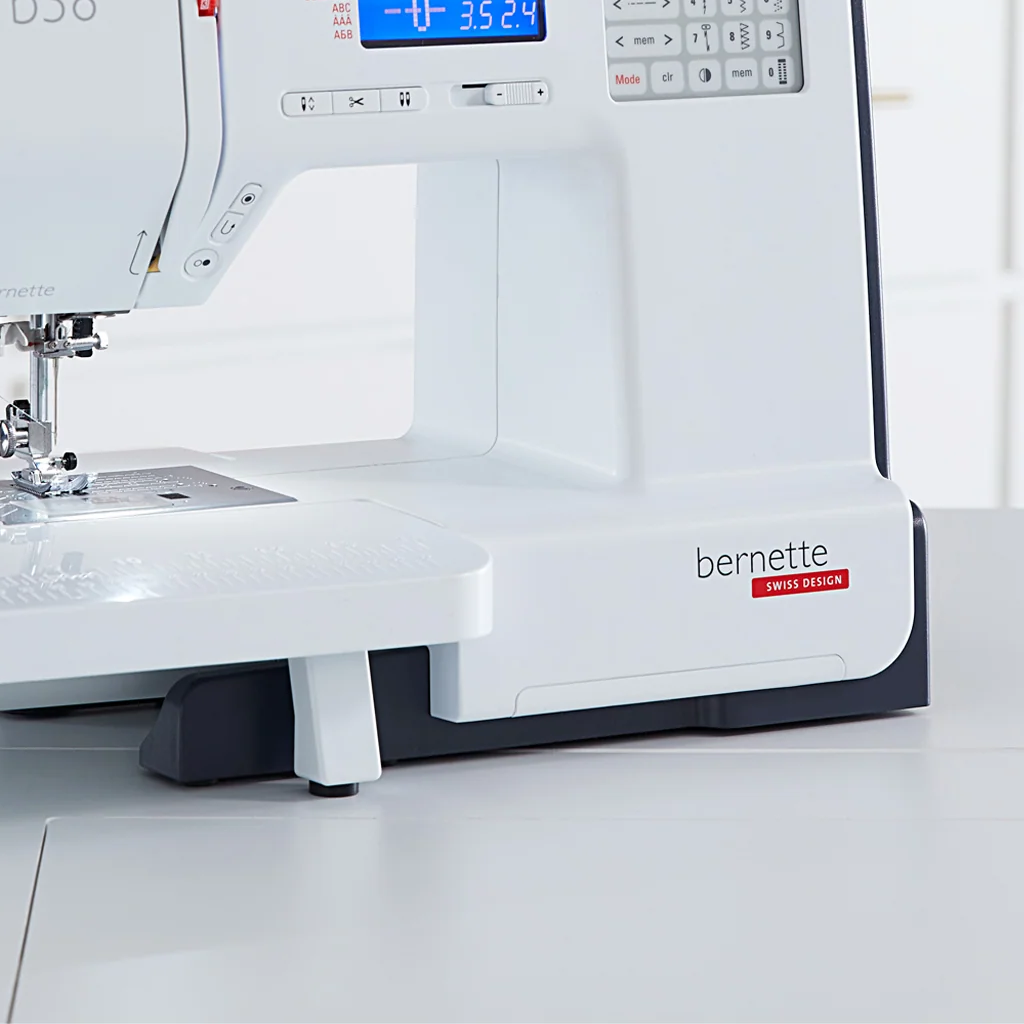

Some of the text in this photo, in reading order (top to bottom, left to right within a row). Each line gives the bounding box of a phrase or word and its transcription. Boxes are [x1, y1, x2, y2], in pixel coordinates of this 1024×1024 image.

[332, 2, 351, 13] ABC
[459, 0, 493, 31] 3.5
[692, 33, 698, 43] 7
[729, 31, 735, 42] 8
[765, 29, 771, 40] 9
[633, 35, 655, 46] mem
[662, 72, 673, 83] clr
[731, 68, 753, 79] mem
[768, 67, 774, 78] 0
[615, 74, 641, 85] Mode
[696, 540, 829, 579] bernette
[766, 574, 843, 592] SWISS DESIGN
